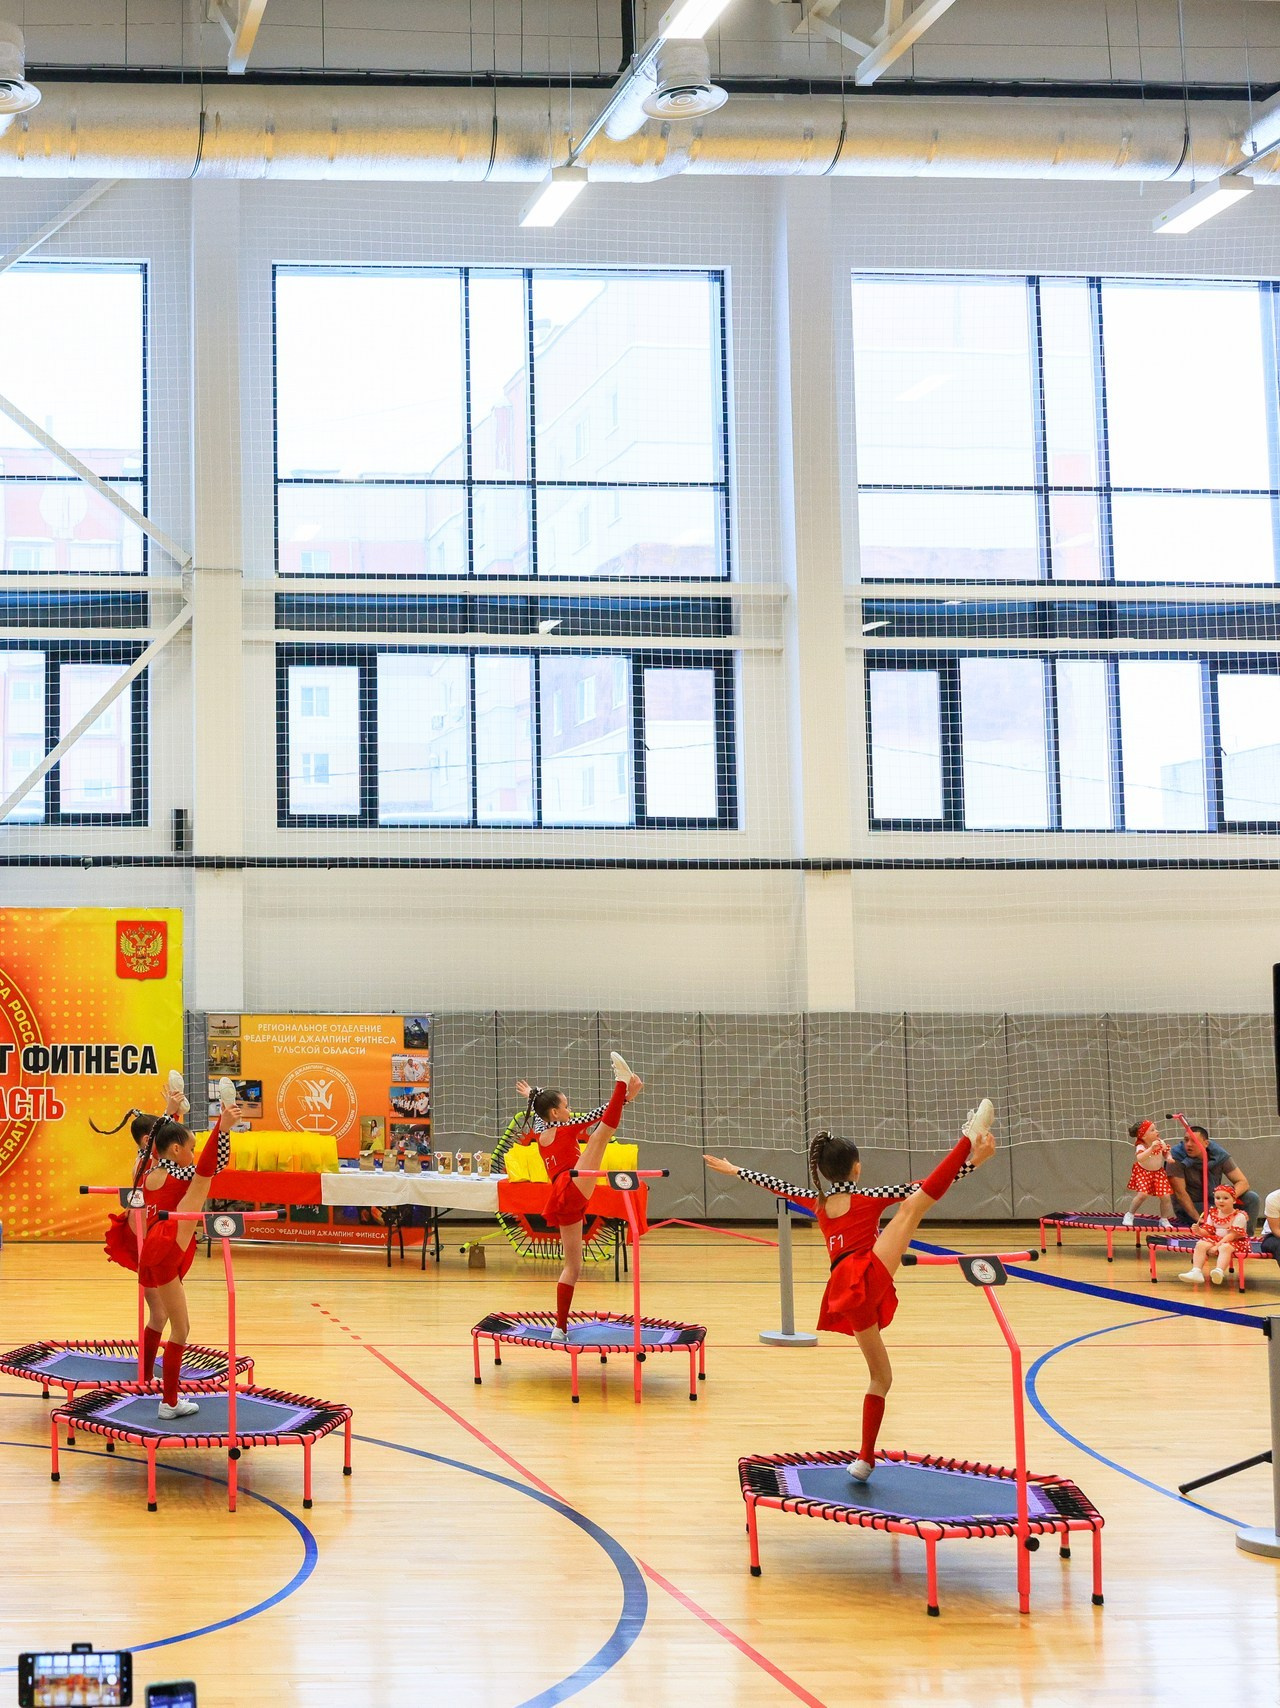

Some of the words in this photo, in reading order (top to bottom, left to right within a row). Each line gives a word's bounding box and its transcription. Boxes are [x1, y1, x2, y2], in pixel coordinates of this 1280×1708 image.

[7, 999, 36, 1047] РОСС
[258, 1023, 327, 1033] РЕГИОНАЛЬНОЕ
[330, 1024, 382, 1034] ОТДЕЛЕНИЕ
[243, 1034, 296, 1044] ФЕДЕРАЦИИ
[299, 1035, 351, 1045] ДЖАМПИНГ
[354, 1036, 396, 1045] ФИТНЕСА
[273, 1044, 320, 1055] ТУЛЬСКОЙ
[322, 1046, 366, 1055] ОБЛАСТИ
[22, 1042, 159, 1076] ФИТНЕСА
[544, 1155, 557, 1170] F1
[146, 1204, 157, 1218] F1
[317, 1229, 354, 1238] ДЖАМПИНГ
[829, 1234, 844, 1251] F1
